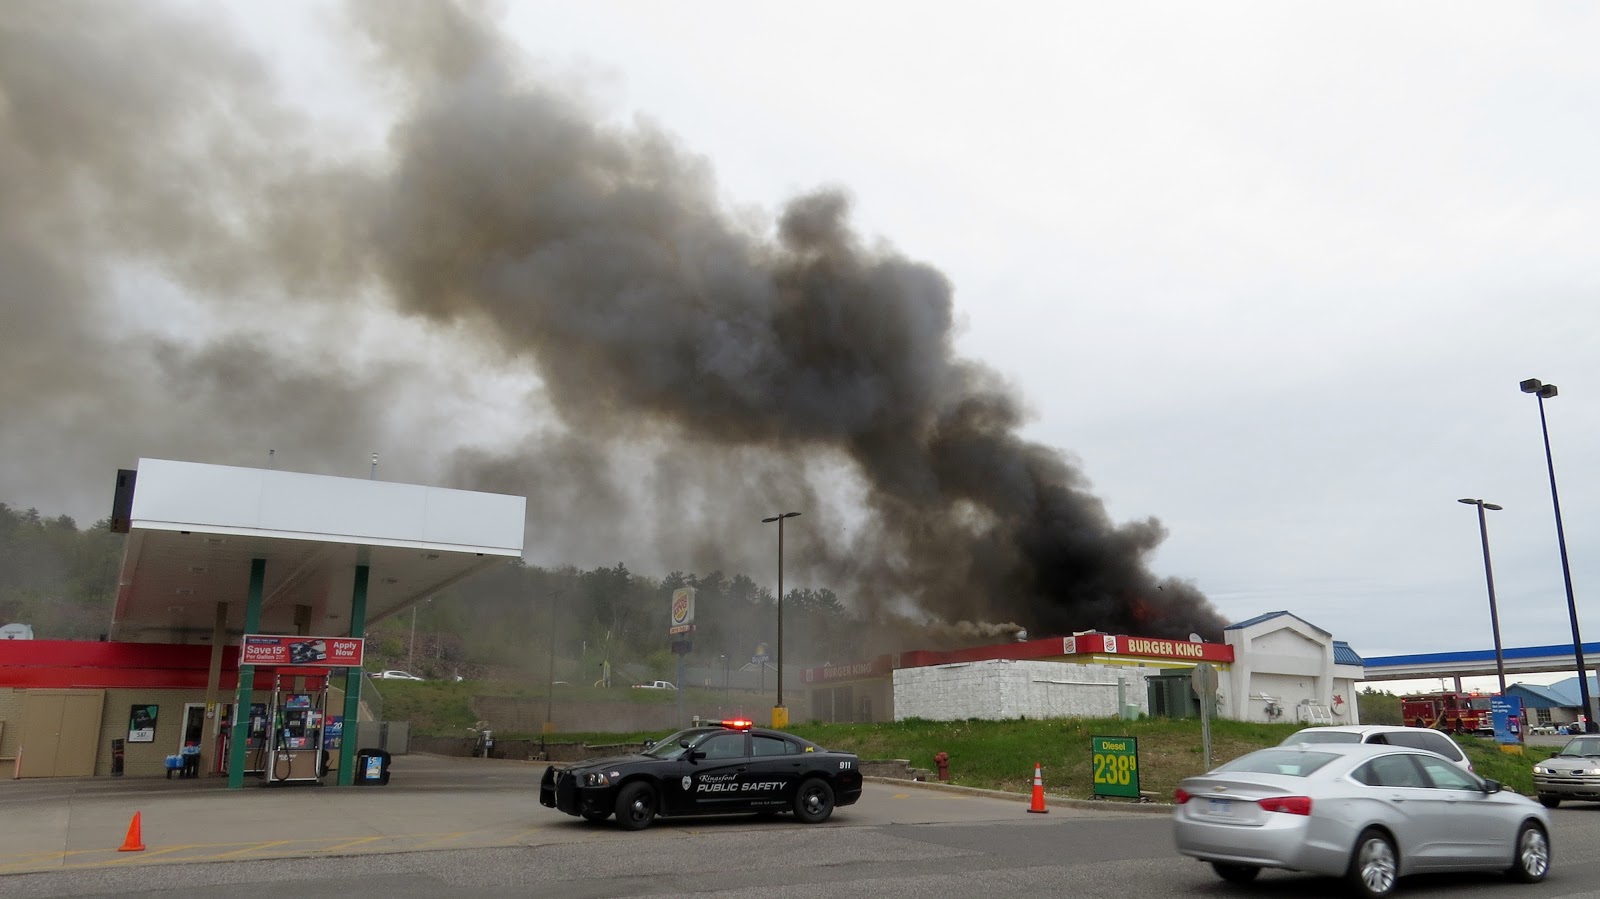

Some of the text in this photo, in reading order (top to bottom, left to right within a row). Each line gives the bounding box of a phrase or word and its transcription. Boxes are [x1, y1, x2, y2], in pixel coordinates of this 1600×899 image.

[247, 645, 272, 654] Save
[333, 641, 357, 650] Apply
[1128, 639, 1173, 655] BURGER
[1175, 643, 1203, 657] KING
[823, 663, 872, 679] BURGER KING
[1102, 741, 1126, 751] Diesel
[839, 761, 851, 770] 911
[699, 773, 739, 783] Kingsford
[696, 781, 787, 792] PUBLIC SAFETY
